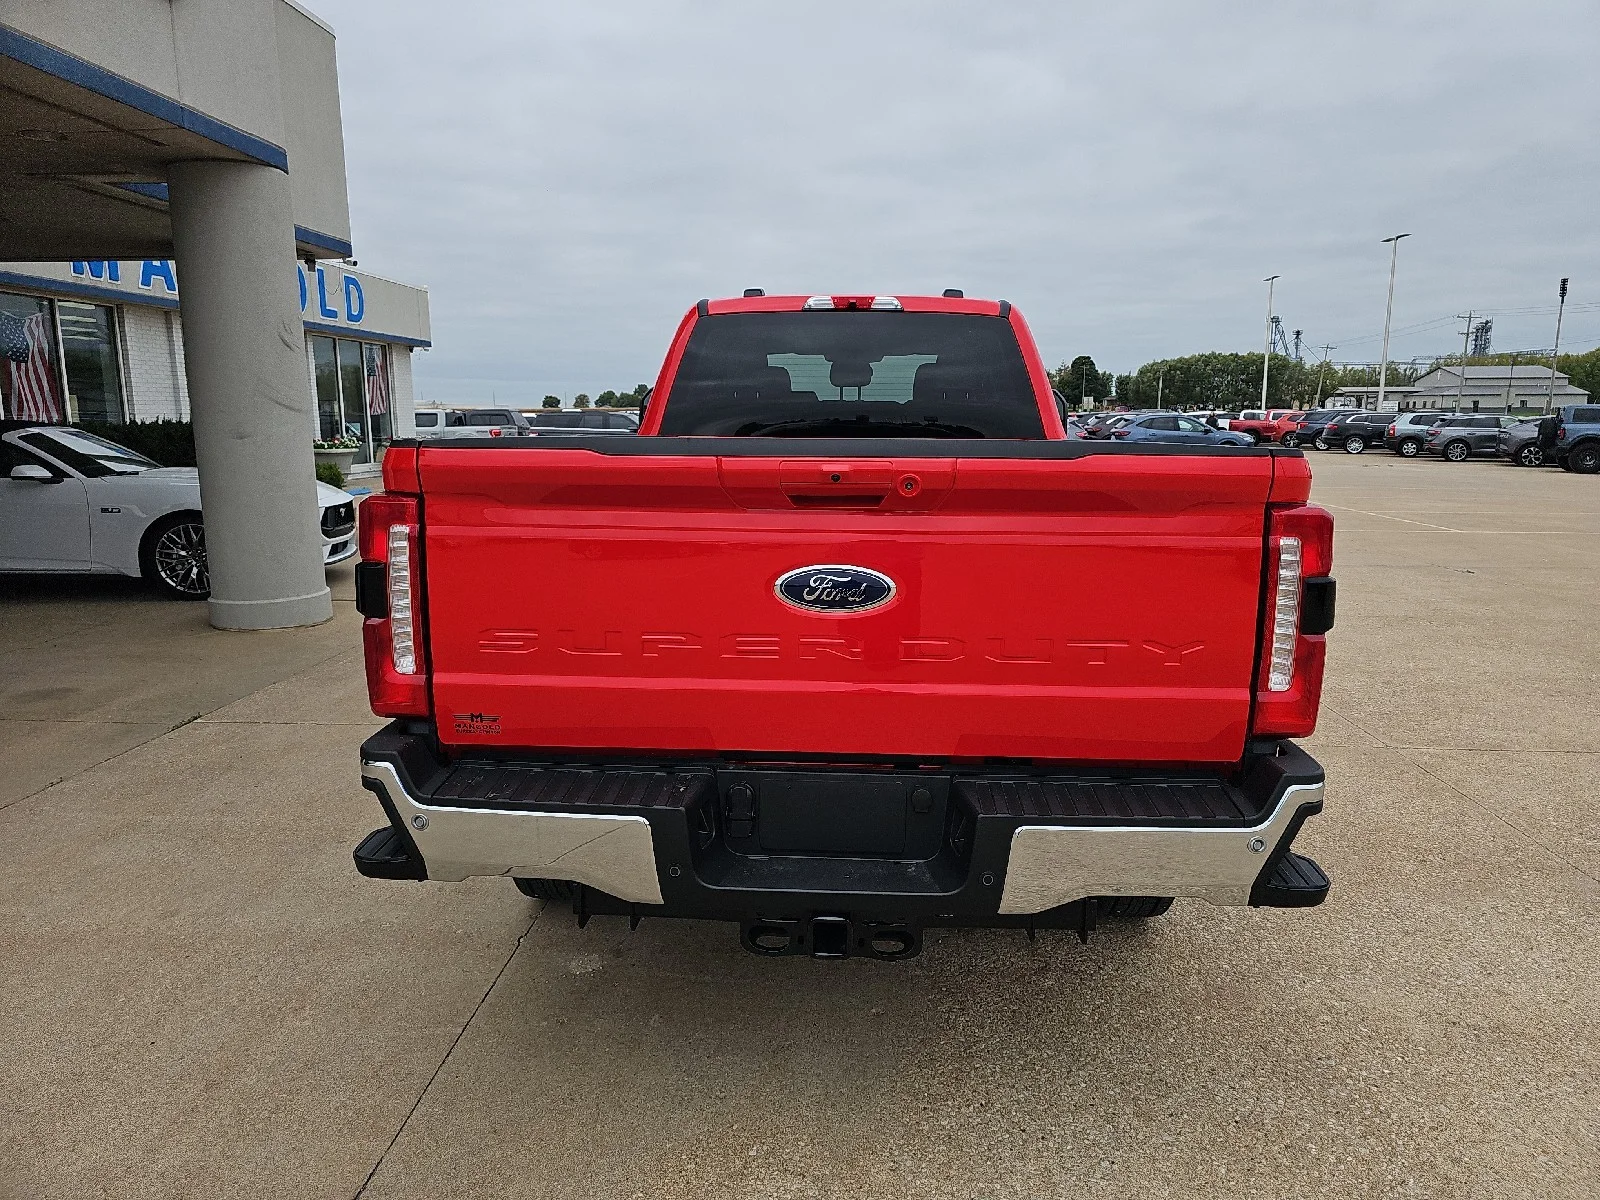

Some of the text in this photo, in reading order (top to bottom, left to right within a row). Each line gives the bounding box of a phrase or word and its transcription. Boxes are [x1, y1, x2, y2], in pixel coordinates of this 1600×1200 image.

[803, 574, 867, 602] Ford
[478, 627, 1205, 666] SUPER DUTY
